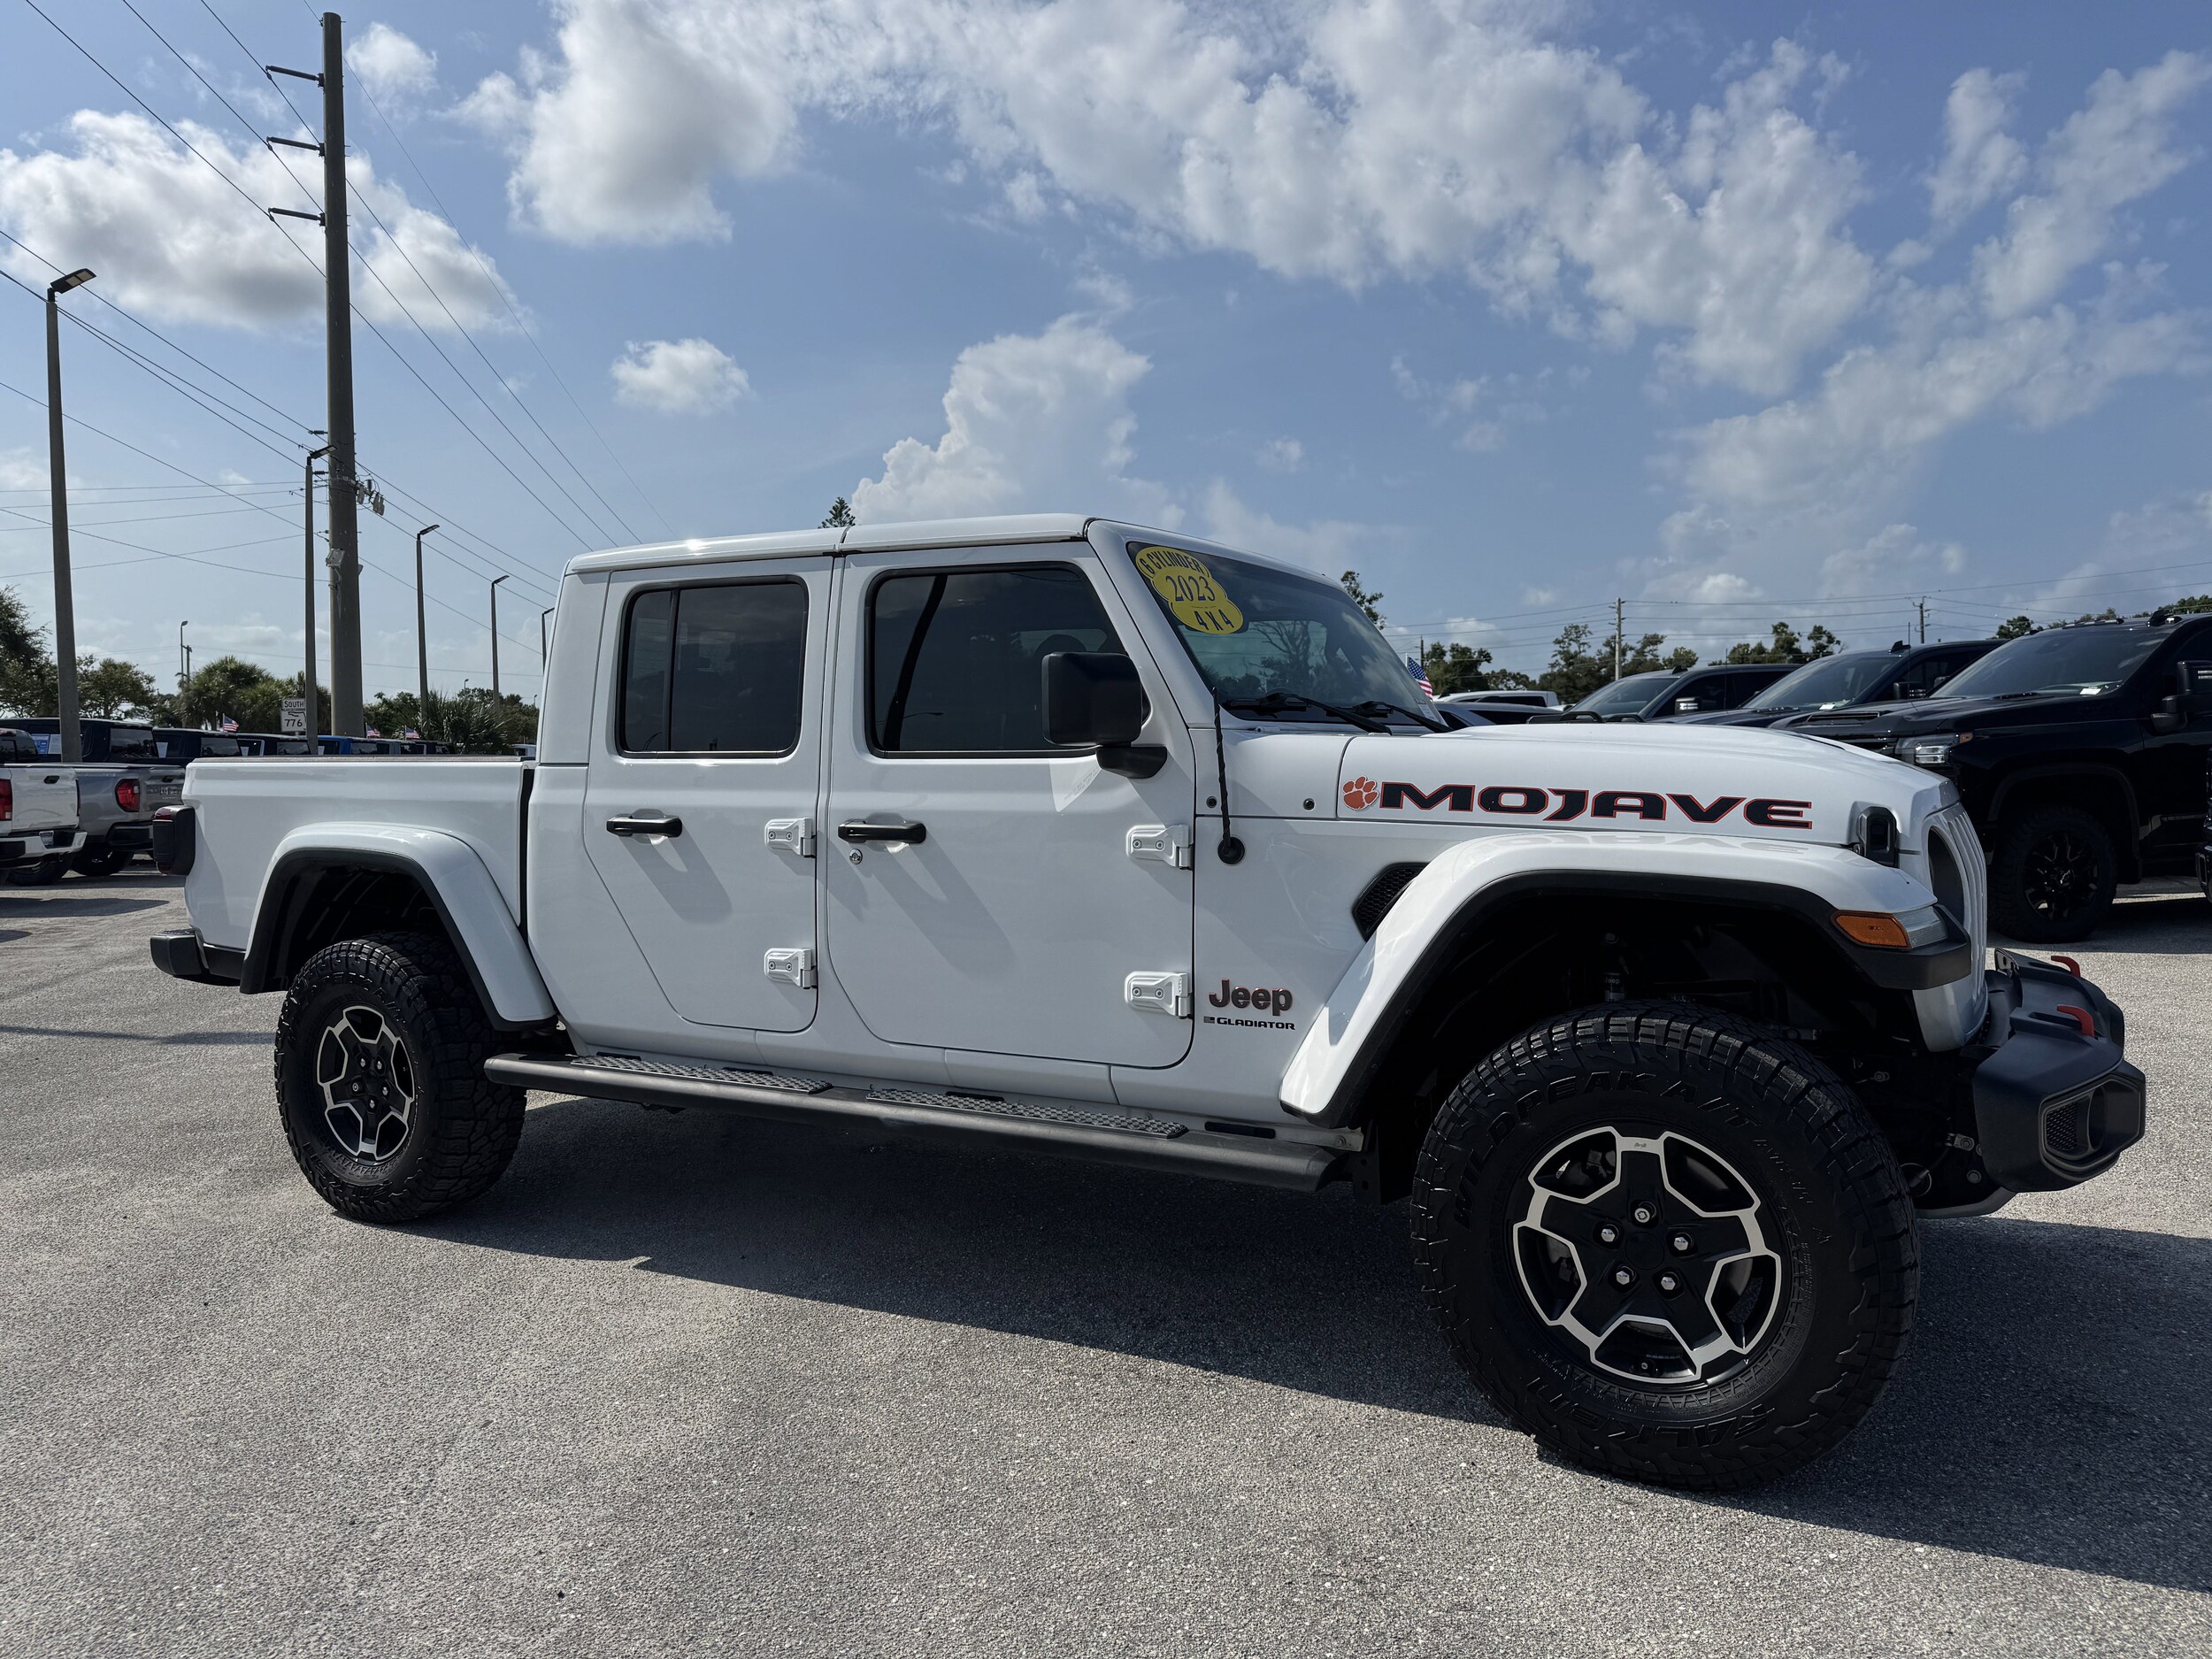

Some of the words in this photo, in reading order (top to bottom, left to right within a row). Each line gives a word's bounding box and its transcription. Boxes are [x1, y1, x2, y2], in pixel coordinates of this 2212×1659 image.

[1139, 557, 1156, 575] 6
[1146, 550, 1205, 575] CYLINDER
[1165, 574, 1216, 602] 2023
[284, 718, 303, 727] 776
[1379, 781, 1813, 830] MOJAVE
[1209, 978, 1293, 1017] Jeep
[1217, 1017, 1295, 1031] GLADIATOR
